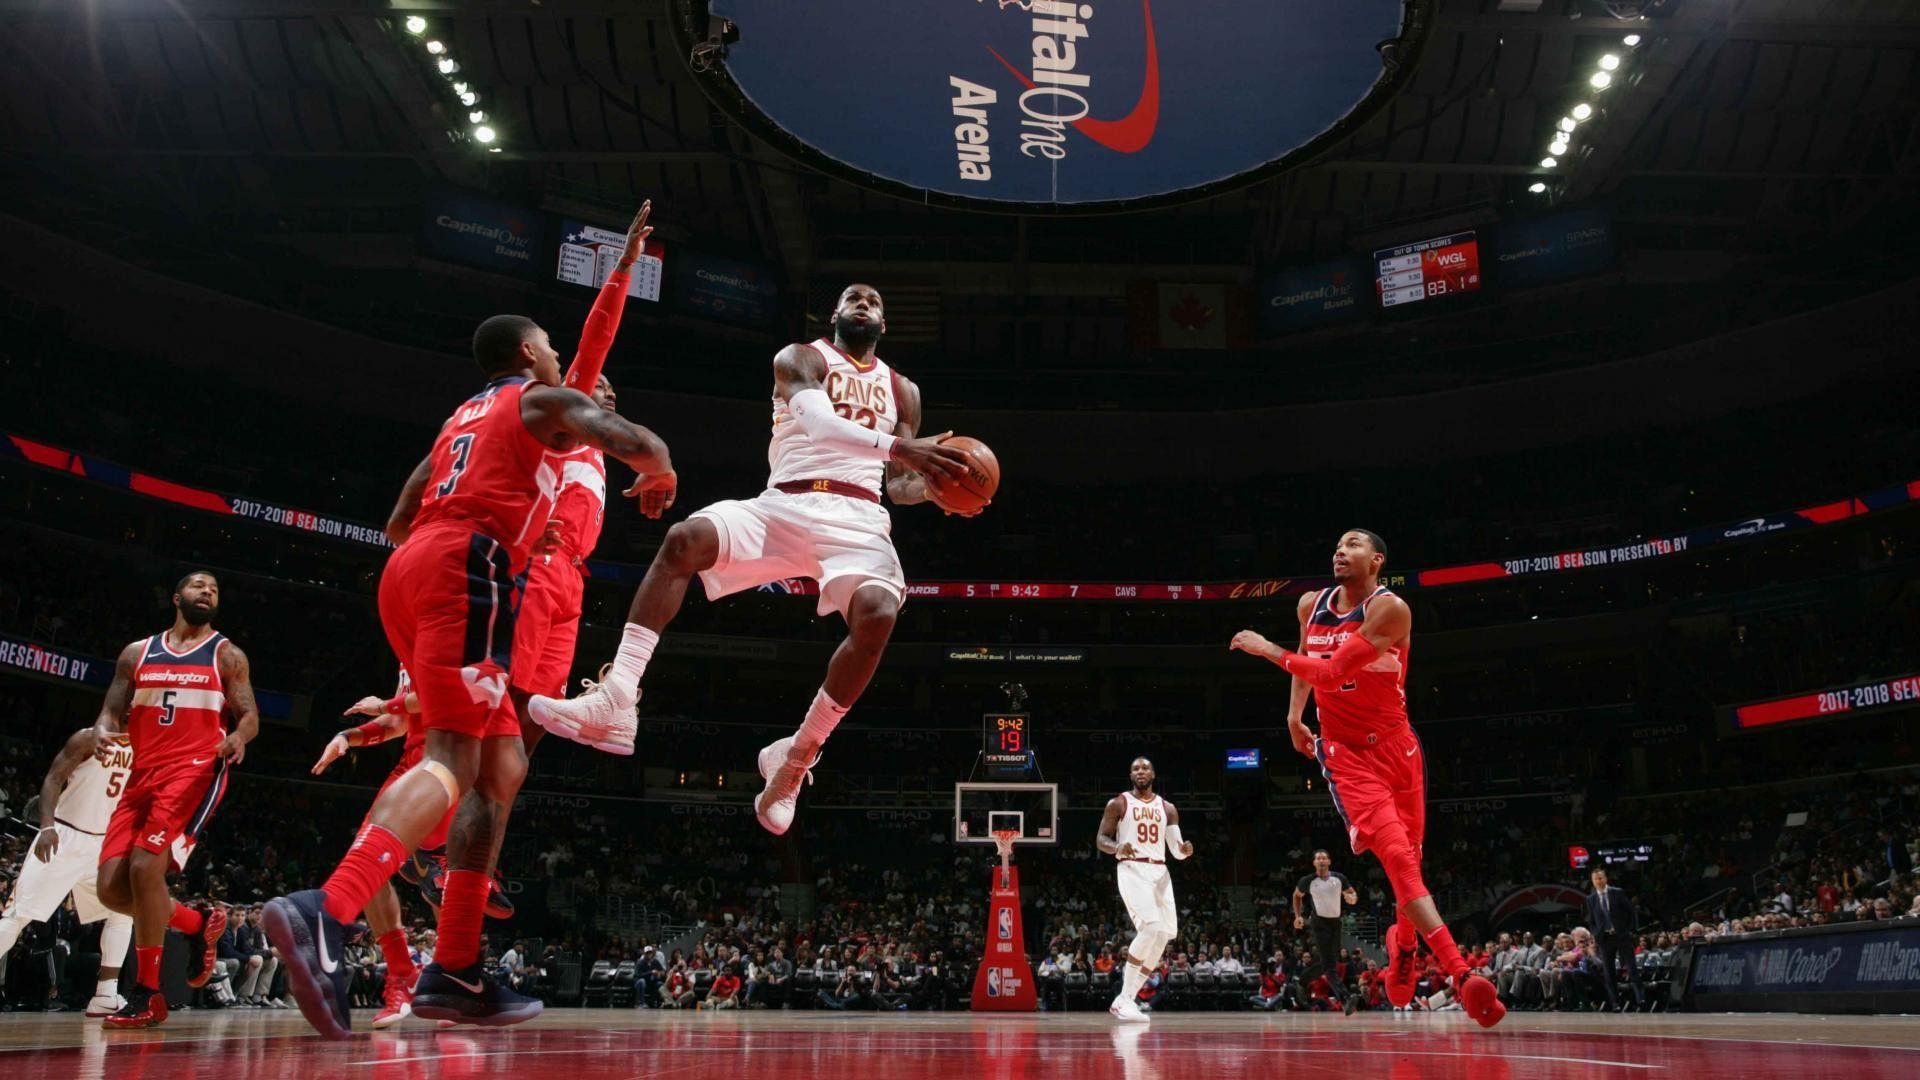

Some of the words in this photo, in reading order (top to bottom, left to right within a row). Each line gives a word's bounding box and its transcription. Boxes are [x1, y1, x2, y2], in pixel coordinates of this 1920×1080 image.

[950, 76, 997, 181] Arena
[495, 244, 530, 260] Bank
[1414, 242, 1430, 252] TOWN
[1430, 238, 1452, 248] SCORES
[1437, 251, 1467, 266] WGL
[1324, 297, 1354, 311] Bank
[828, 371, 887, 415] CAVS
[436, 433, 476, 499] 3
[813, 480, 829, 491] CLE
[232, 499, 294, 526] 2017-2018
[296, 512, 342, 536] SEASON
[1505, 555, 1561, 575] 2017-2018
[1563, 550, 1608, 569] SEASON
[1610, 540, 1671, 562] PRESENTED
[1673, 536, 1688, 552] BY
[966, 585, 975, 597] 5
[1011, 585, 1040, 597] 9:42
[1069, 585, 1078, 597] 7
[1115, 586, 1136, 597] CAVS
[1391, 576, 1405, 586] PM
[0, 640, 68, 677] RESENTED
[70, 659, 89, 680] BY
[140, 669, 209, 685] washington
[1818, 683, 1889, 712] 2017-2018
[1892, 676, 1920, 701] SEA
[159, 690, 177, 725] 5
[997, 718, 1023, 731] 9:42
[1001, 730, 1021, 752] 19
[106, 771, 124, 798] 5
[1133, 806, 1162, 822] CAVS
[1137, 823, 1159, 844] 99
[1784, 947, 1836, 985] Cares
